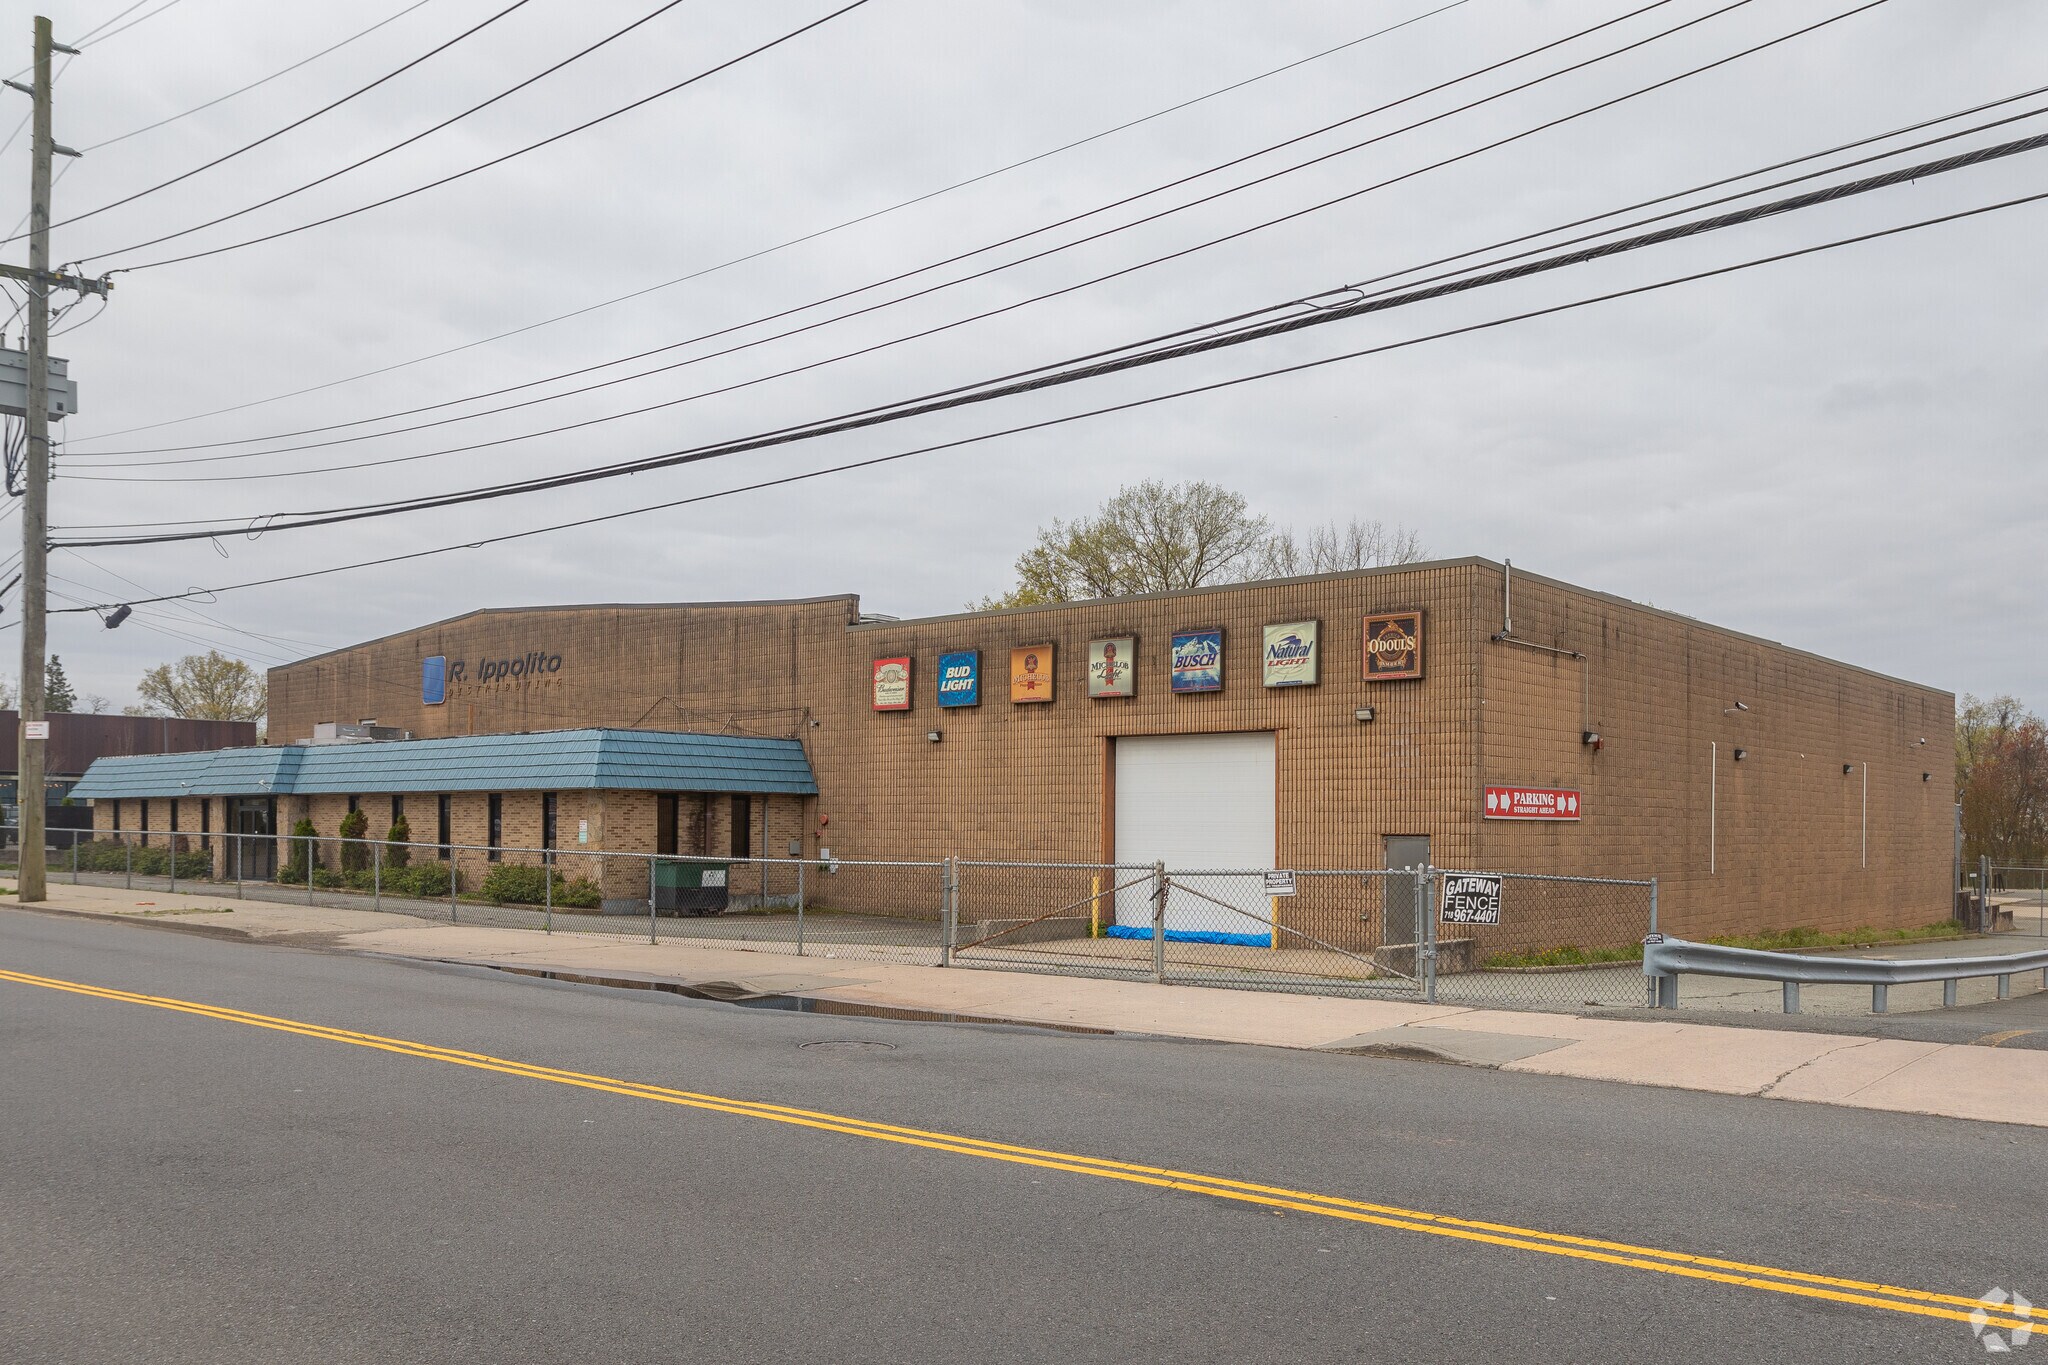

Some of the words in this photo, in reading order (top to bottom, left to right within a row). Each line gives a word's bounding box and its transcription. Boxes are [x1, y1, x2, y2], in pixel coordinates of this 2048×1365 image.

[1266, 641, 1313, 660] Natural
[1174, 653, 1217, 668] BUSCH
[1268, 658, 1309, 666] LIGHT
[449, 661, 467, 683] R.
[478, 652, 562, 684] Ippolito
[946, 666, 971, 679] BUD
[449, 679, 563, 698] DISTRIBUTING
[941, 678, 974, 692] LIGHT
[1513, 792, 1554, 806] PARKING
[1513, 806, 1538, 814] STRAIGHT
[1445, 878, 1499, 897] GATEWAY
[1444, 895, 1499, 910] FENCE
[1444, 911, 1454, 919] 718
